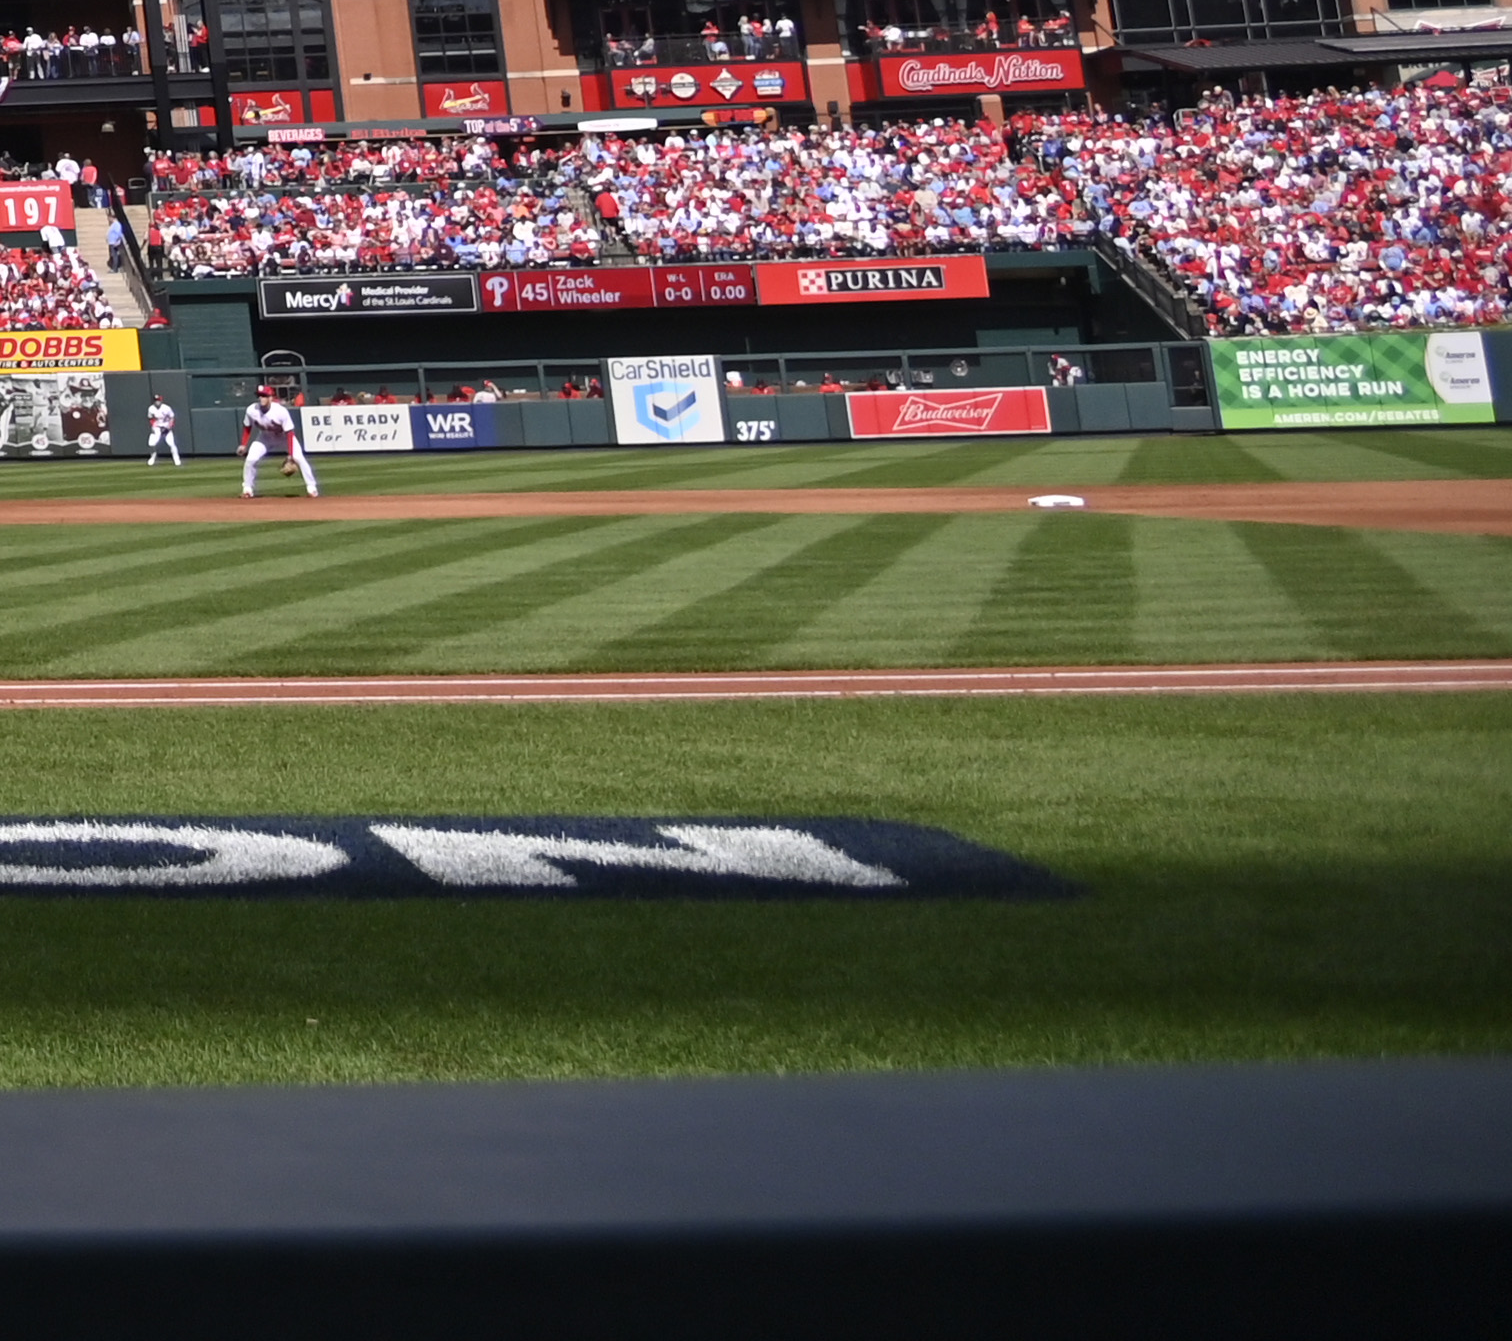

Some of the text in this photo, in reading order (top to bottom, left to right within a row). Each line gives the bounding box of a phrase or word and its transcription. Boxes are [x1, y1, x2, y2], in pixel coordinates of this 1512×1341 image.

[900, 55, 1064, 92] Cardinals Nation
[268, 128, 323, 142] BEVERAGES
[463, 120, 485, 134] TOP
[4, 196, 59, 226] 197
[666, 271, 734, 283] W-L ERA
[828, 269, 940, 290] PURINA
[521, 273, 595, 302] 45 Zack
[664, 285, 746, 301] 0-0 0.00
[285, 285, 429, 310] Mercy Medical Provider
[371, 297, 384, 306] the
[416, 295, 453, 305] Cardinals
[557, 288, 621, 305] Wheeler
[58, 359, 102, 367] CENTERS
[1236, 348, 1320, 365] ENERGY
[611, 359, 712, 381] CarShield
[1239, 365, 1364, 382] EFFICIENCY
[1242, 380, 1403, 400] IS A HOME RUN
[311, 413, 401, 427] BE READY
[904, 403, 993, 422] Budweiser
[1273, 409, 1440, 425] AMEREN.COM/REBATES
[316, 428, 397, 443] for Real
[736, 420, 776, 442] 375'
